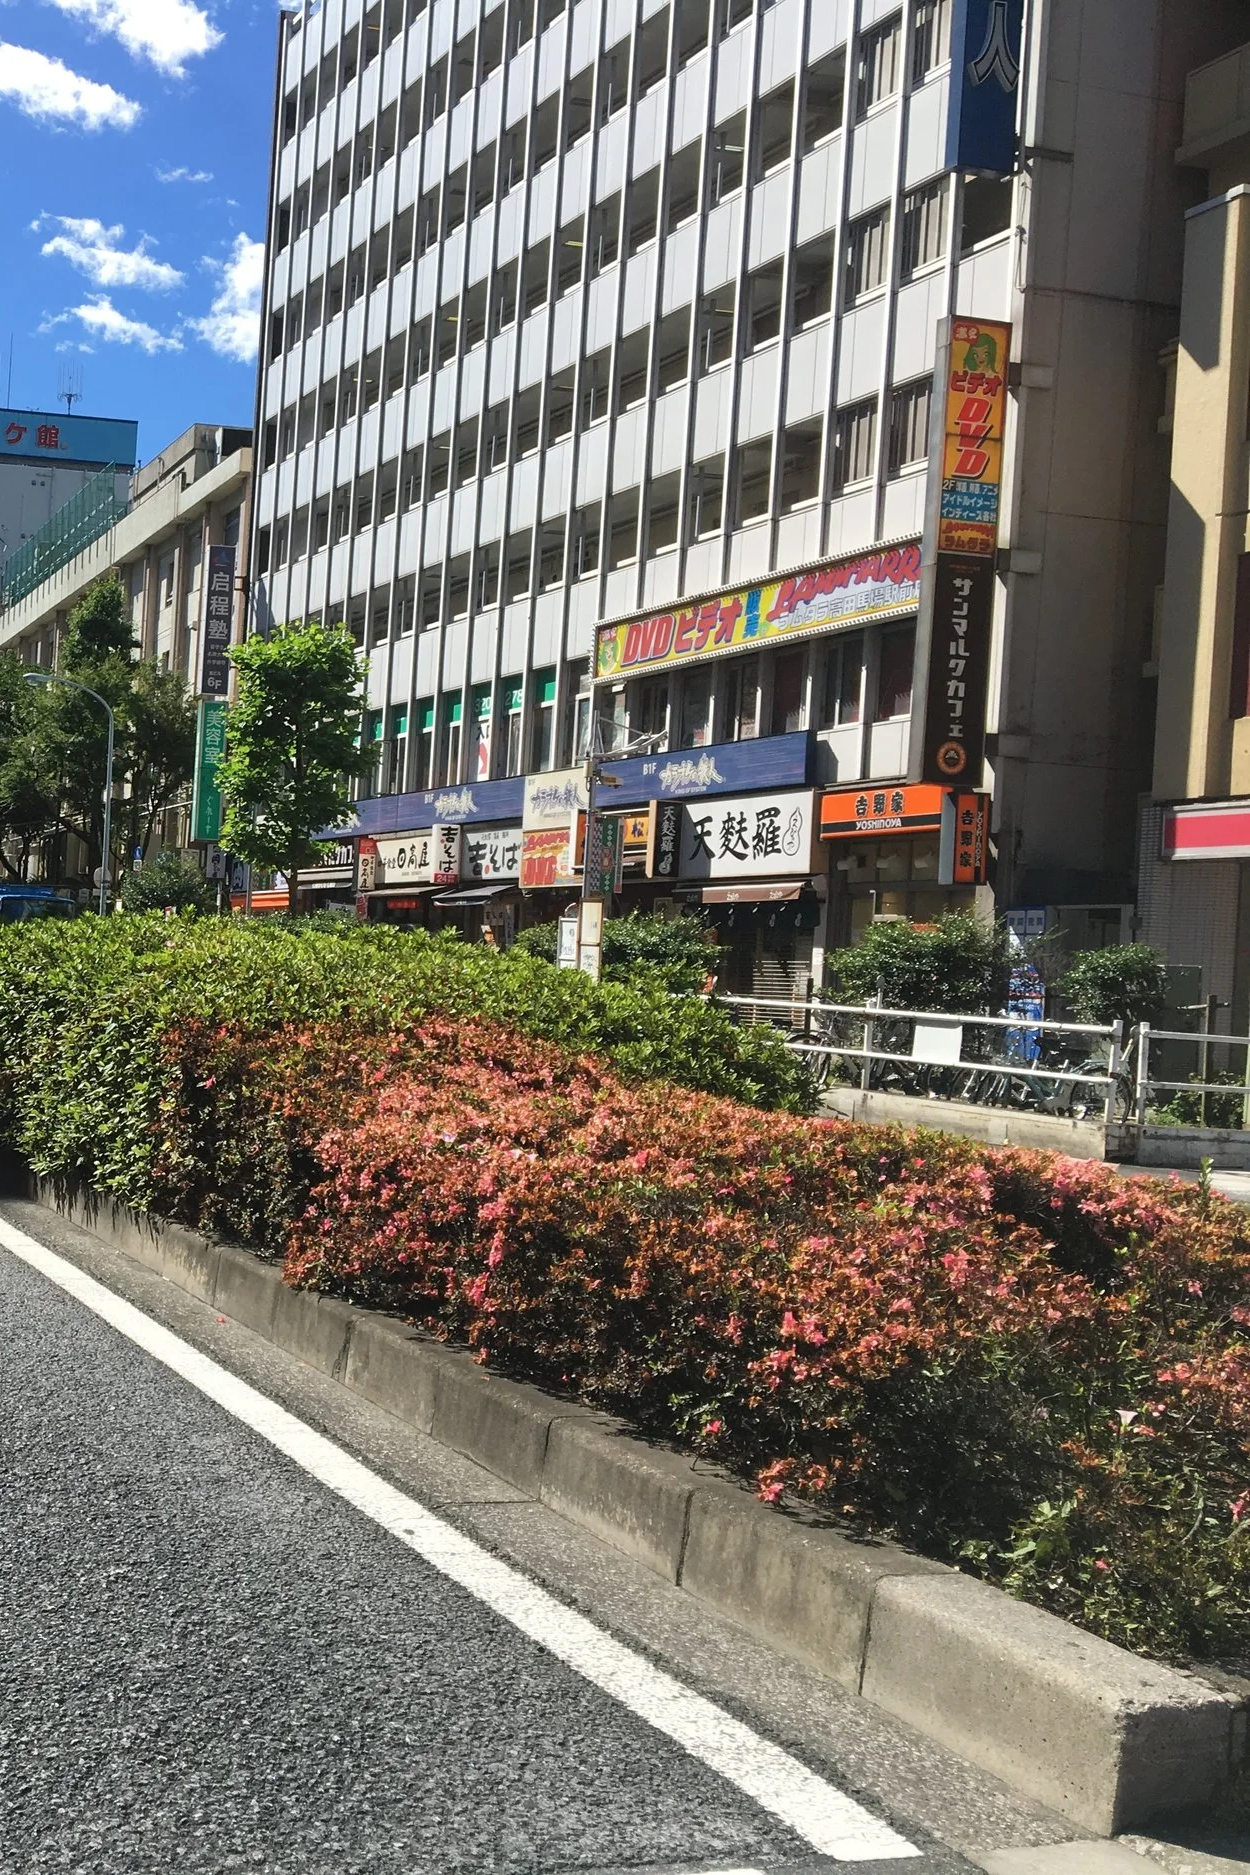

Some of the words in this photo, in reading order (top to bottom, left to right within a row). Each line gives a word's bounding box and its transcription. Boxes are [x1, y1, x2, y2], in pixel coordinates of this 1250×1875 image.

[950, 370, 1003, 397] ビデオ
[952, 397, 994, 480] DVD
[942, 480, 956, 490] 2F
[942, 493, 998, 509] アイドルイメージ
[947, 578, 973, 738] サンマルクカフェ
[207, 676, 223, 690] 6F
[204, 709, 222, 764] 美容室
[643, 762, 657, 775] B1F
[855, 790, 904, 817] 吉野家
[661, 806, 677, 852] 天麩羅
[689, 806, 782, 861] 天麩羅
[855, 817, 902, 831] YOSHINOYA
[960, 809, 974, 867] 吉野家
[975, 811, 983, 867] YOSHINOYA
[397, 841, 430, 869] 日高屋
[440, 825, 459, 873] 吉そば
[468, 841, 521, 876] 吉そば
[359, 858, 369, 889] 日高屋
[436, 874, 448, 884] 24
